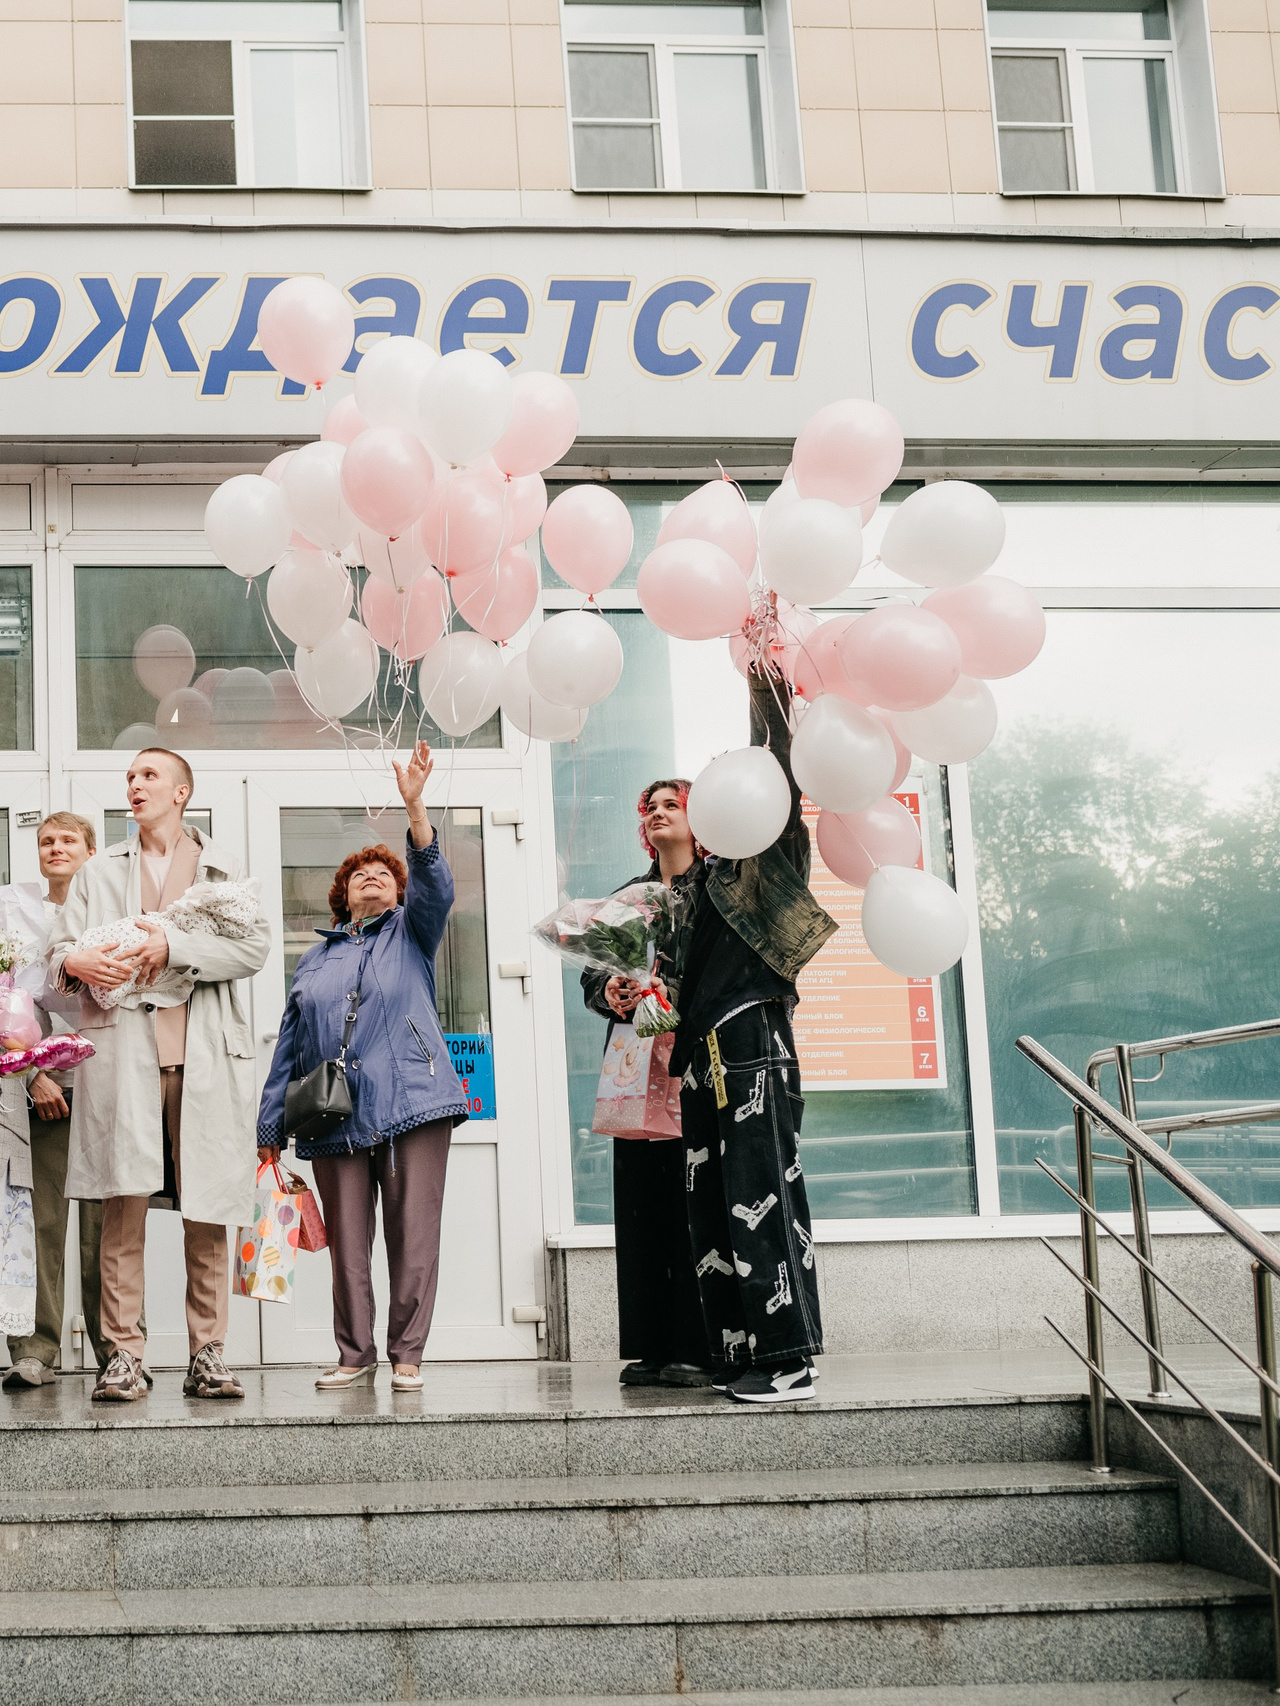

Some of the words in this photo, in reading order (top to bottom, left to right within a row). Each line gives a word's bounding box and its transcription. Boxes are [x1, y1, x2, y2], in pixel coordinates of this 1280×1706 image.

[903, 796, 910, 807] 1
[917, 1006, 927, 1018] 6
[813, 1026, 887, 1034] ФИЗИОЛОГИЧЕСКОЕ
[920, 1053, 930, 1065] 7
